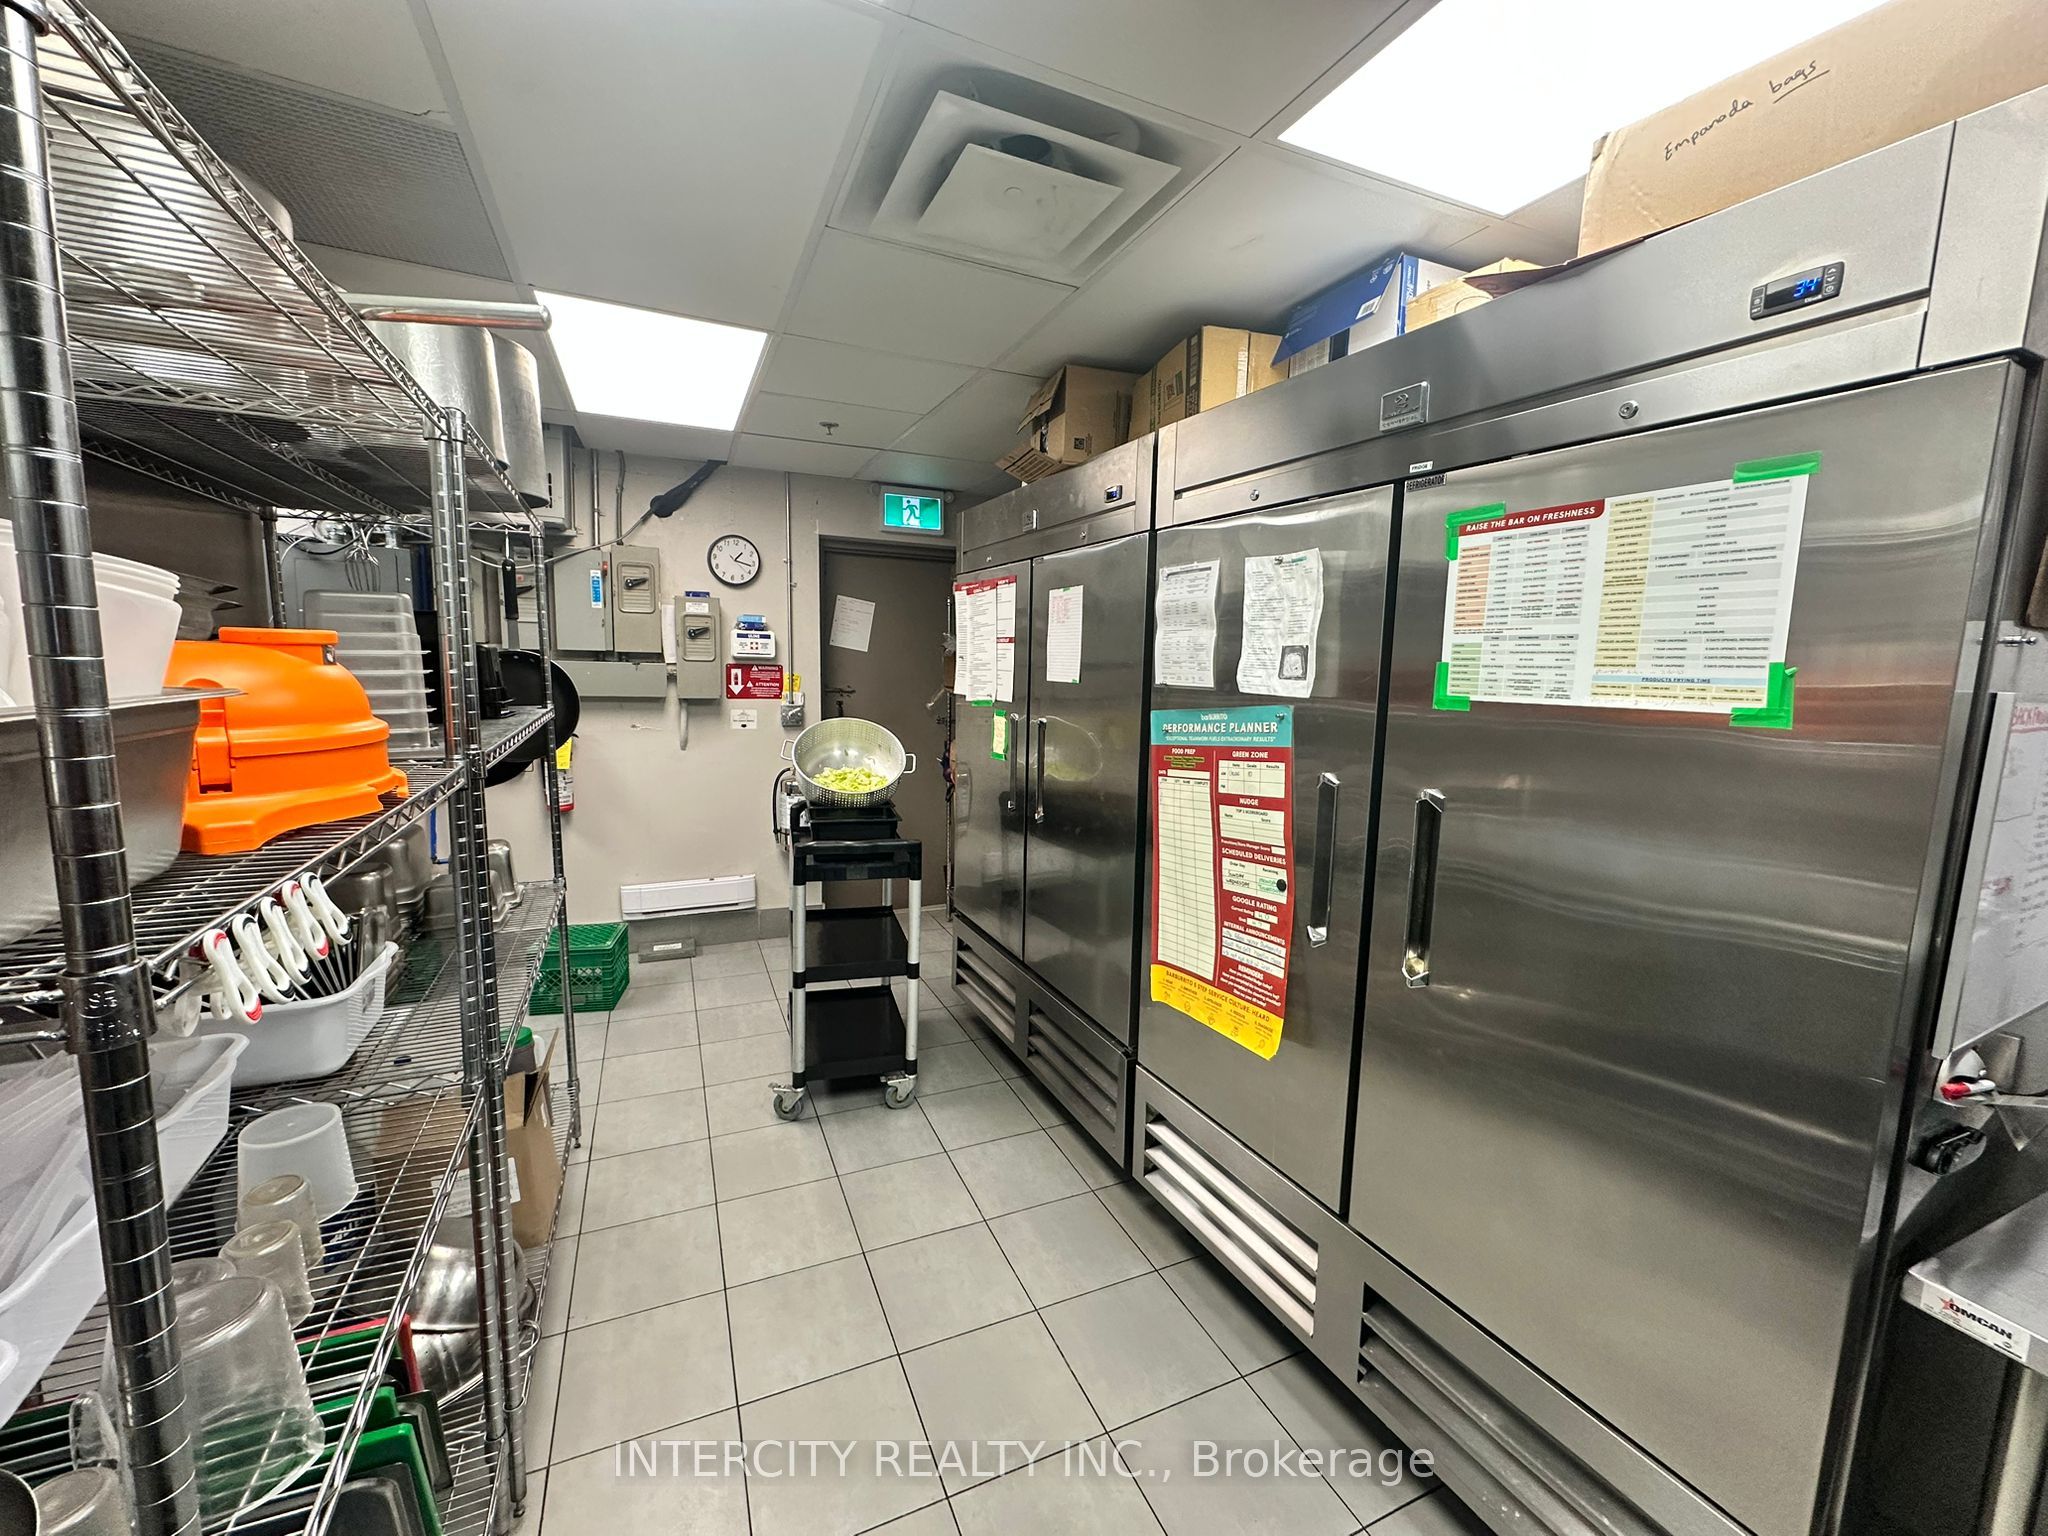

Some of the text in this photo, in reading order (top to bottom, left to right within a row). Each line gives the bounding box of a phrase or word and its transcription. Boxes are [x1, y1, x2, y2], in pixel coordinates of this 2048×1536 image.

[1664, 60, 1817, 161] Empanada bags
[1406, 475, 1445, 490] REFRIGERATOR
[1466, 506, 1596, 532] RAISE THE BAR ON FRESHNESS
[1229, 722, 1278, 733] PLANNER
[1250, 751, 1269, 759] ZONE
[1239, 798, 1259, 806] NUDGE
[1222, 847, 1287, 865] SCHEDULED DELIVERIES
[1232, 895, 1277, 912] GOOGLE RATING
[1223, 921, 1286, 946] INTERNAL ANNOUNCEMENTS
[1238, 964, 1264, 980] REMINDERS
[1208, 988, 1228, 1003] SERVICE
[1252, 1009, 1270, 1022] HEARD
[1949, 1303, 2013, 1340] OMCAN
